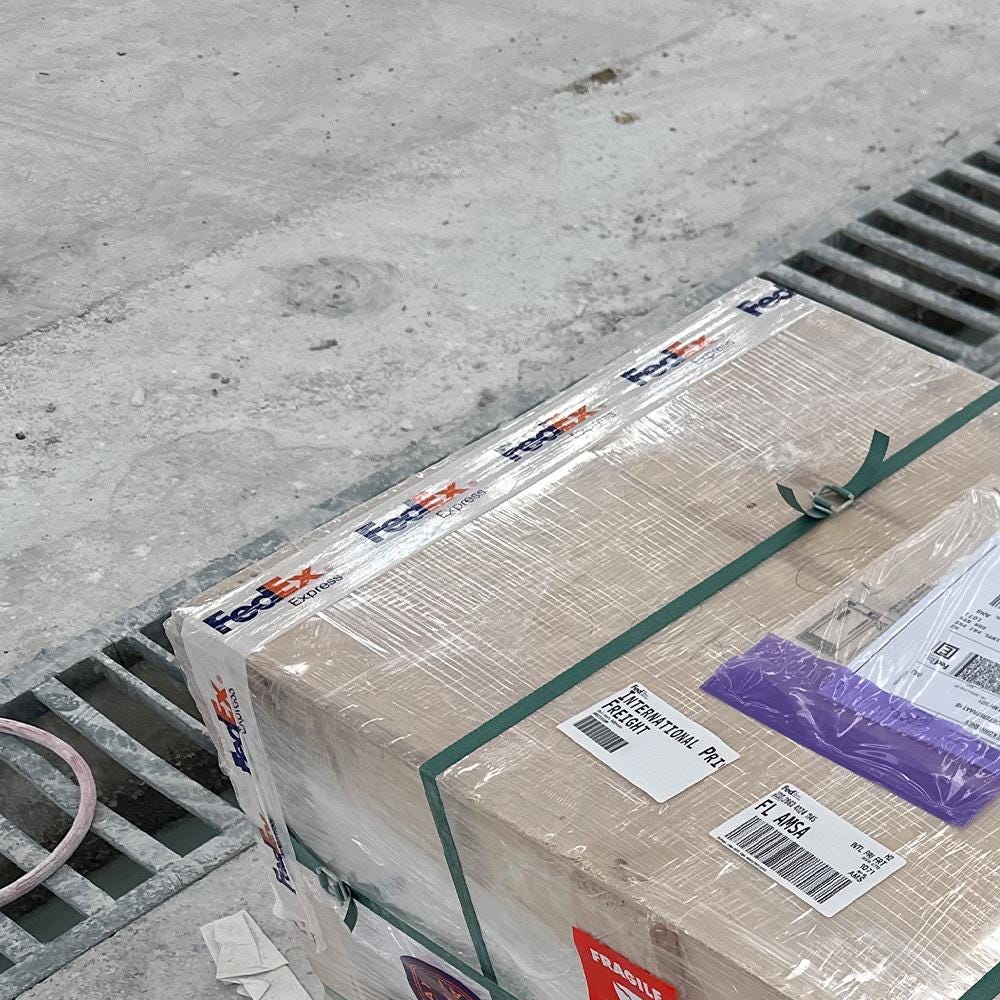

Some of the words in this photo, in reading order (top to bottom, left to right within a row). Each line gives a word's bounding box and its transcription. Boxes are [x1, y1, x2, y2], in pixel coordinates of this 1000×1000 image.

[620, 334, 719, 387] FedEx
[356, 480, 470, 543] FedEx
[435, 487, 487, 519] Express
[203, 565, 324, 635] FedEx
[288, 573, 343, 607] Express
[938, 645, 953, 656] E
[698, 746, 727, 770] PRI
[753, 798, 781, 816] FL
[771, 811, 814, 839] AMSA
[845, 869, 866, 882] AMS
[858, 863, 876, 875] 1071
